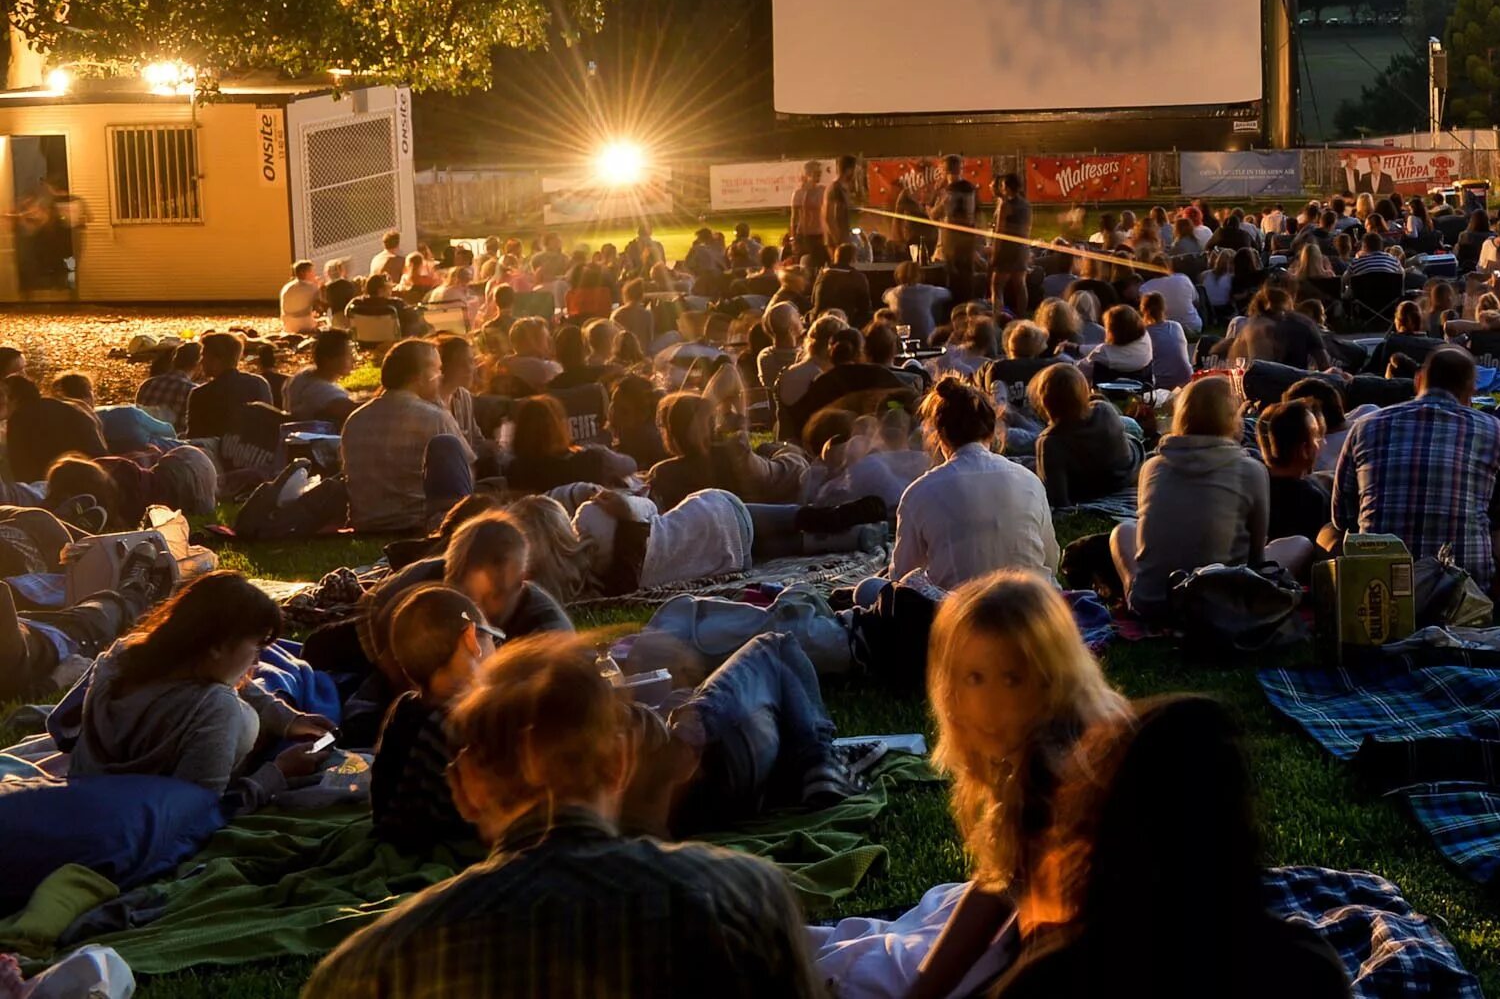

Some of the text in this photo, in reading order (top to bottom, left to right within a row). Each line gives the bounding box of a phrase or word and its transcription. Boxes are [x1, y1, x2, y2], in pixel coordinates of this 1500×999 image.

[1056, 161, 1120, 197] Maltesers
[1396, 165, 1430, 179] WIPPA
[1368, 582, 1384, 641] BULMERS
